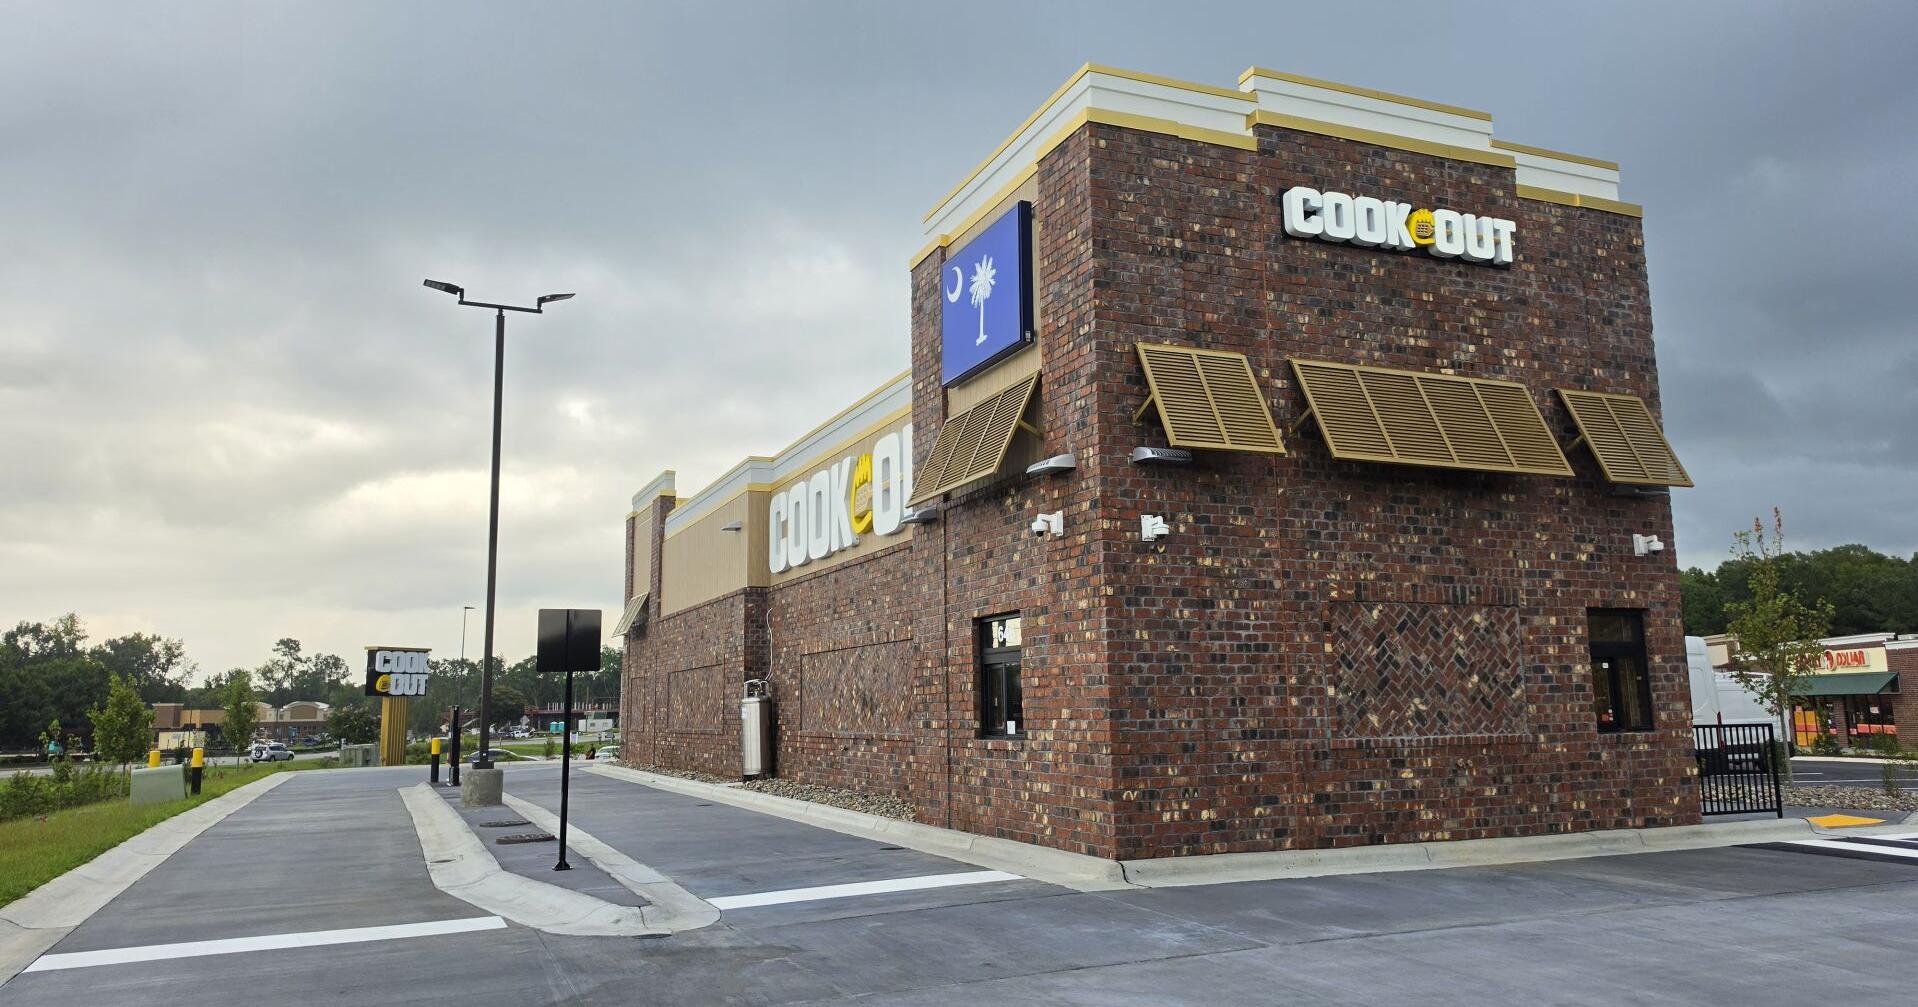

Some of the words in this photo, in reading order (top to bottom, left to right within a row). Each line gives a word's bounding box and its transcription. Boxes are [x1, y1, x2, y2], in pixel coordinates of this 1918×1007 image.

[1282, 186, 1416, 251] COOK
[1428, 209, 1517, 265] OUT
[769, 456, 859, 574] COOK
[375, 650, 431, 673] COOK
[1836, 650, 1866, 666] DOLLAR
[388, 673, 429, 696] OUT
